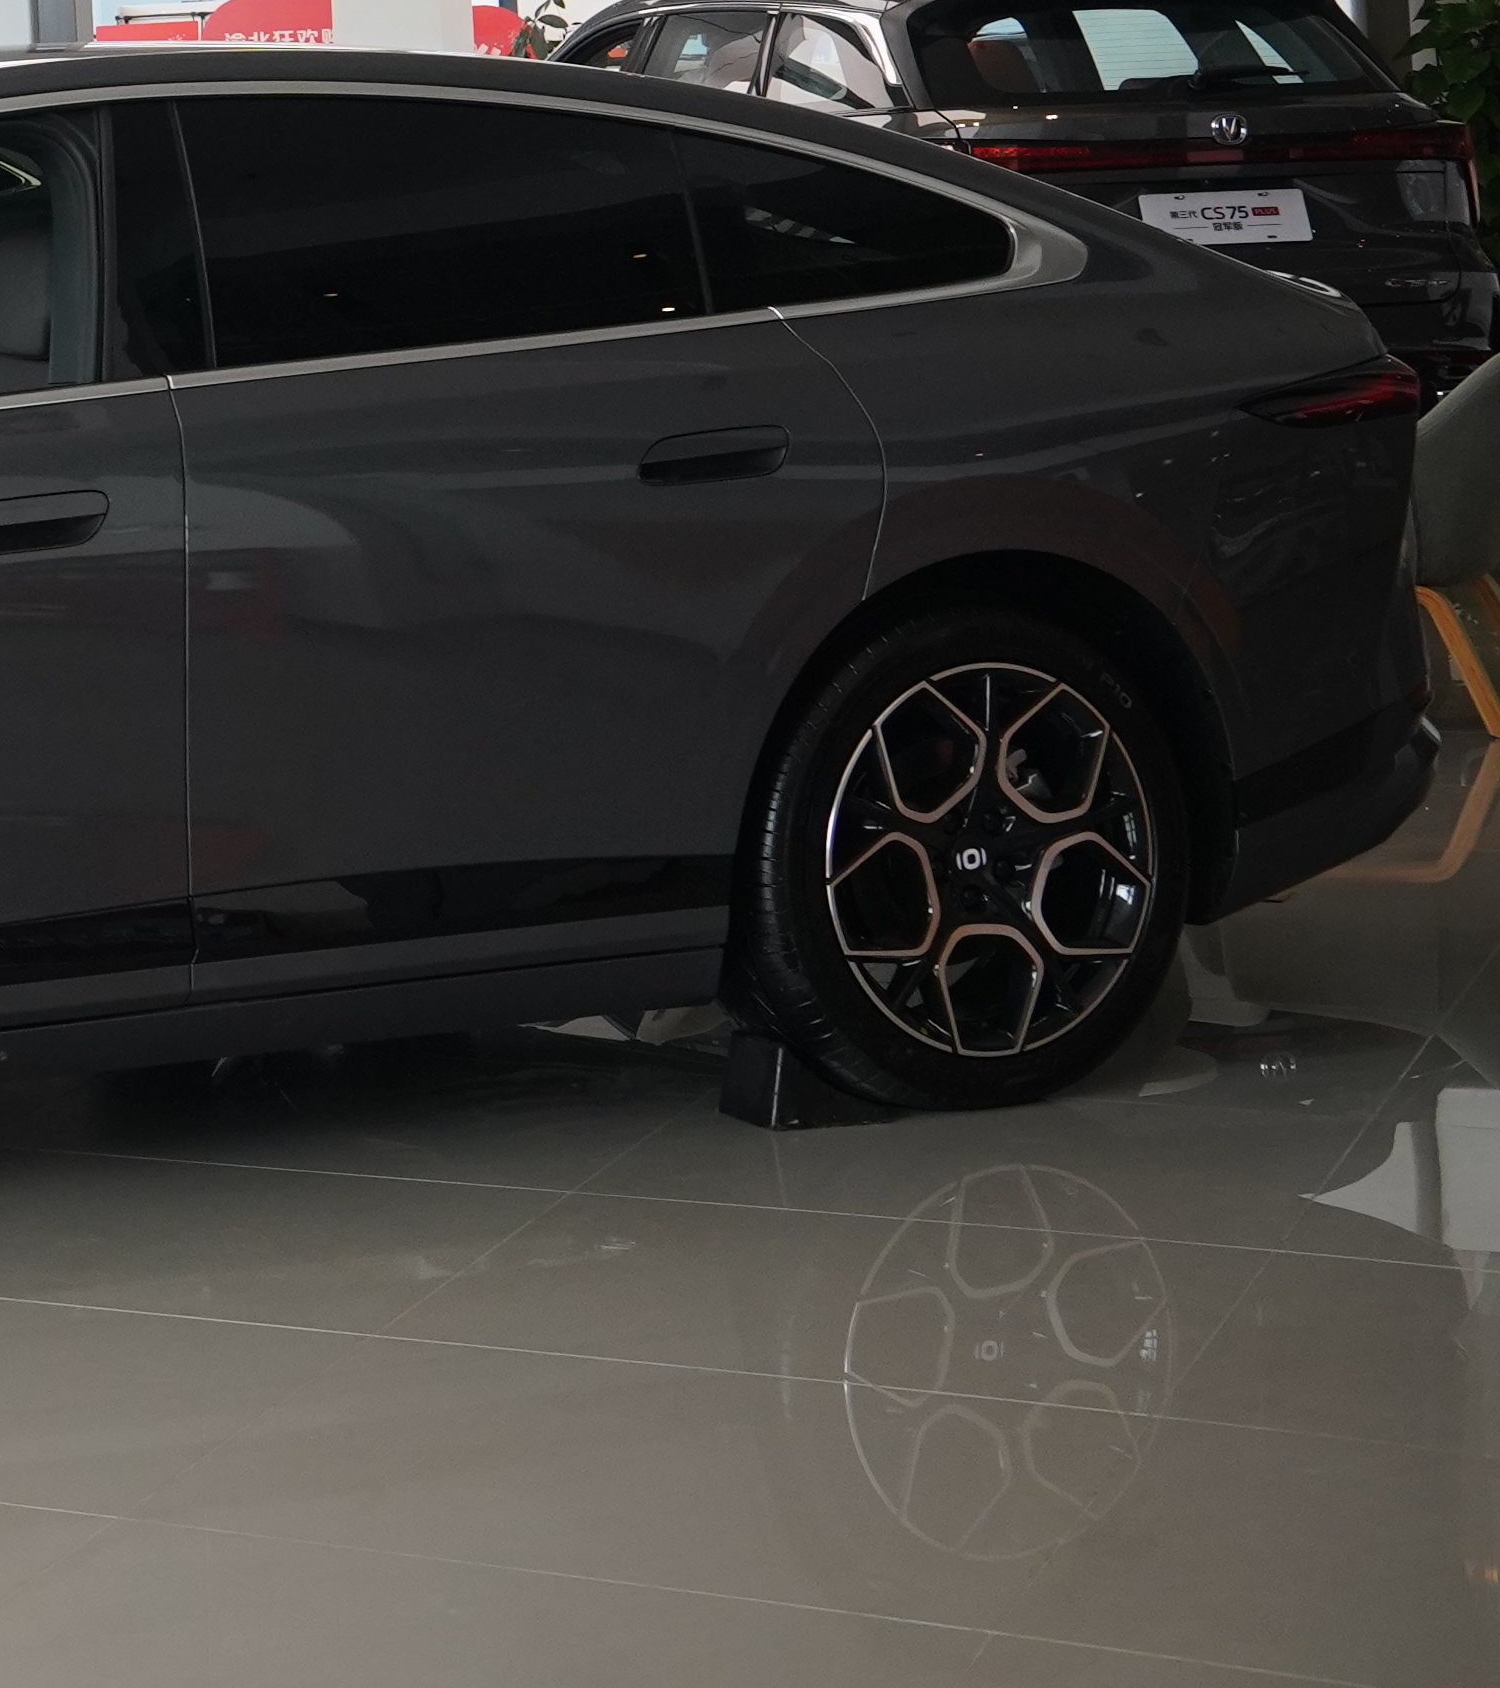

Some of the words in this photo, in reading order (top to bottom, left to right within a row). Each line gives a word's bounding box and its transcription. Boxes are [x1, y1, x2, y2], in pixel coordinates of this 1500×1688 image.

[1170, 210, 1198, 219] 第三代
[1200, 205, 1250, 221] CS75
[1253, 207, 1279, 215] PLUS
[1212, 221, 1243, 231] 冠军版
